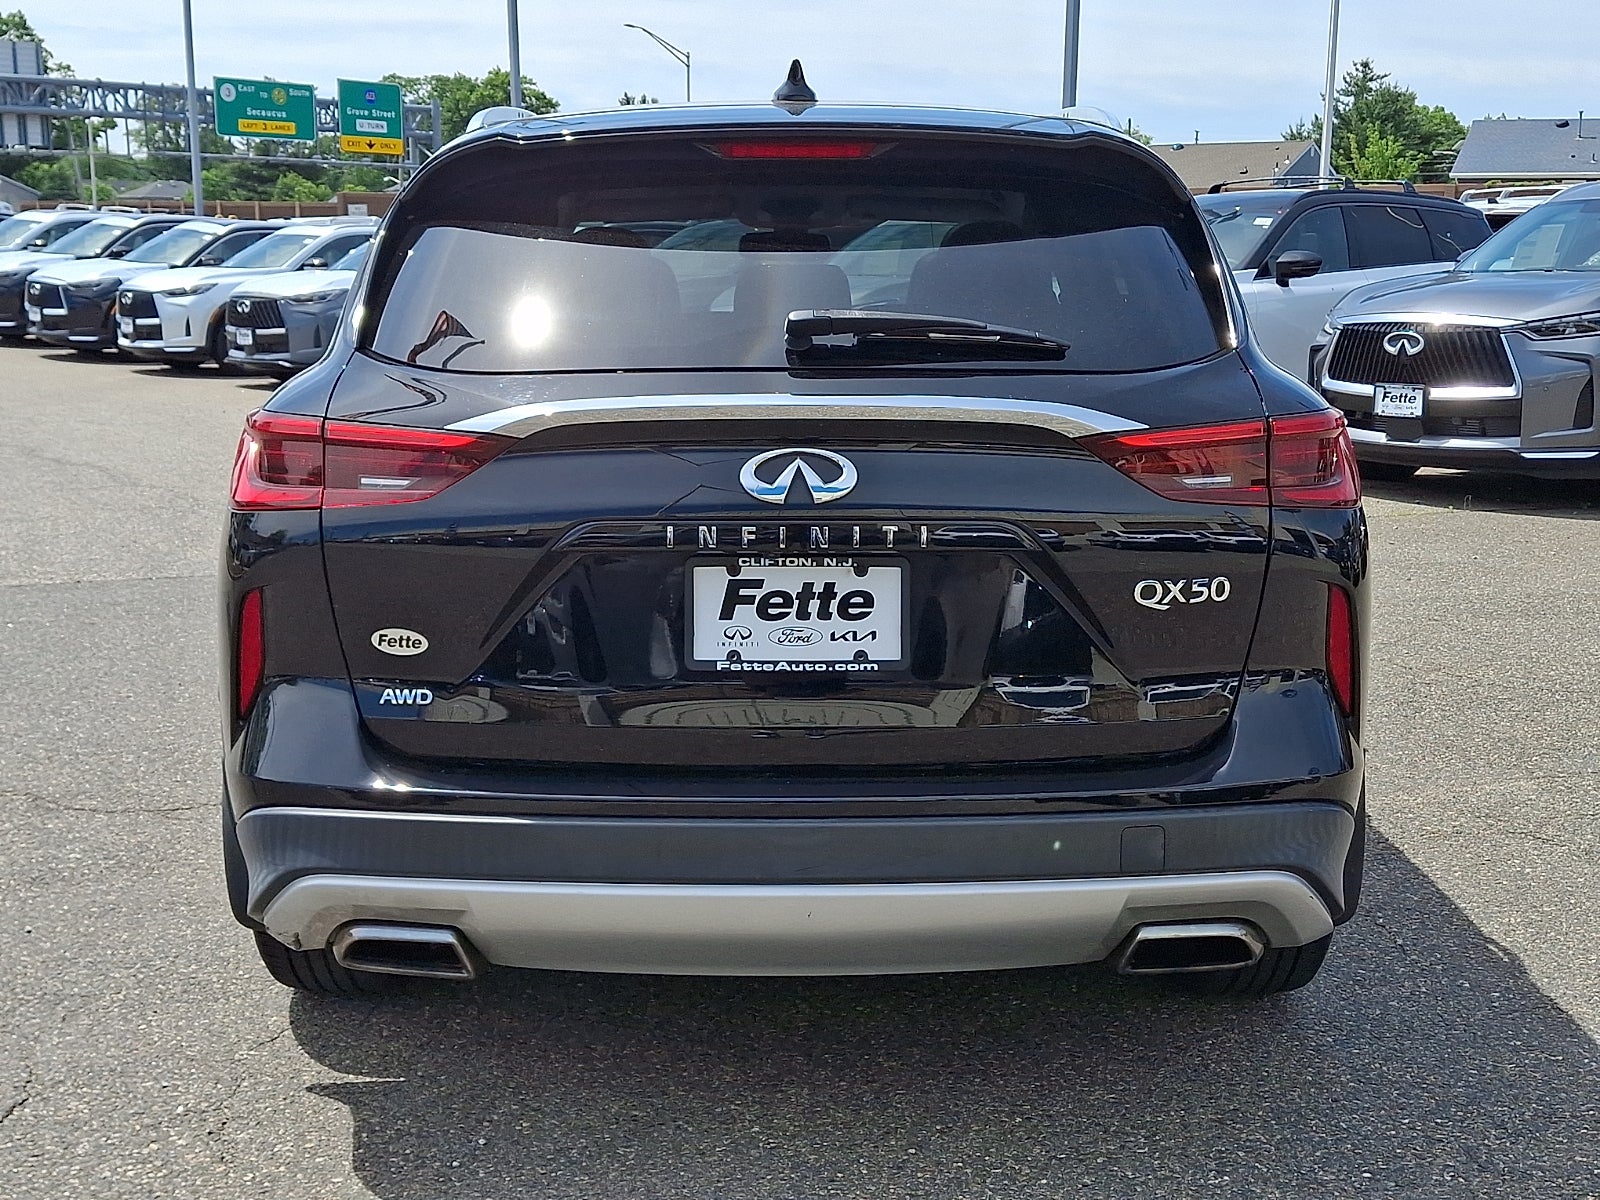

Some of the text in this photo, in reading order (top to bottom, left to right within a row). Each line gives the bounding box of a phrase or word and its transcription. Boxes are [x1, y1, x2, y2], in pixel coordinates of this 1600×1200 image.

[246, 107, 287, 118] Secaucus
[346, 107, 396, 118] Grove Street
[262, 123, 267, 131] 3
[1381, 391, 1417, 404] Fette
[666, 525, 928, 548] INFINITI
[738, 557, 858, 568] CLIFTON, N.J.
[718, 578, 876, 622] Fette
[1133, 576, 1231, 611] QX50
[377, 633, 423, 649] Fette
[777, 628, 813, 644] Ford
[716, 661, 879, 671] FetteAuto.com
[379, 688, 433, 705] AWD
